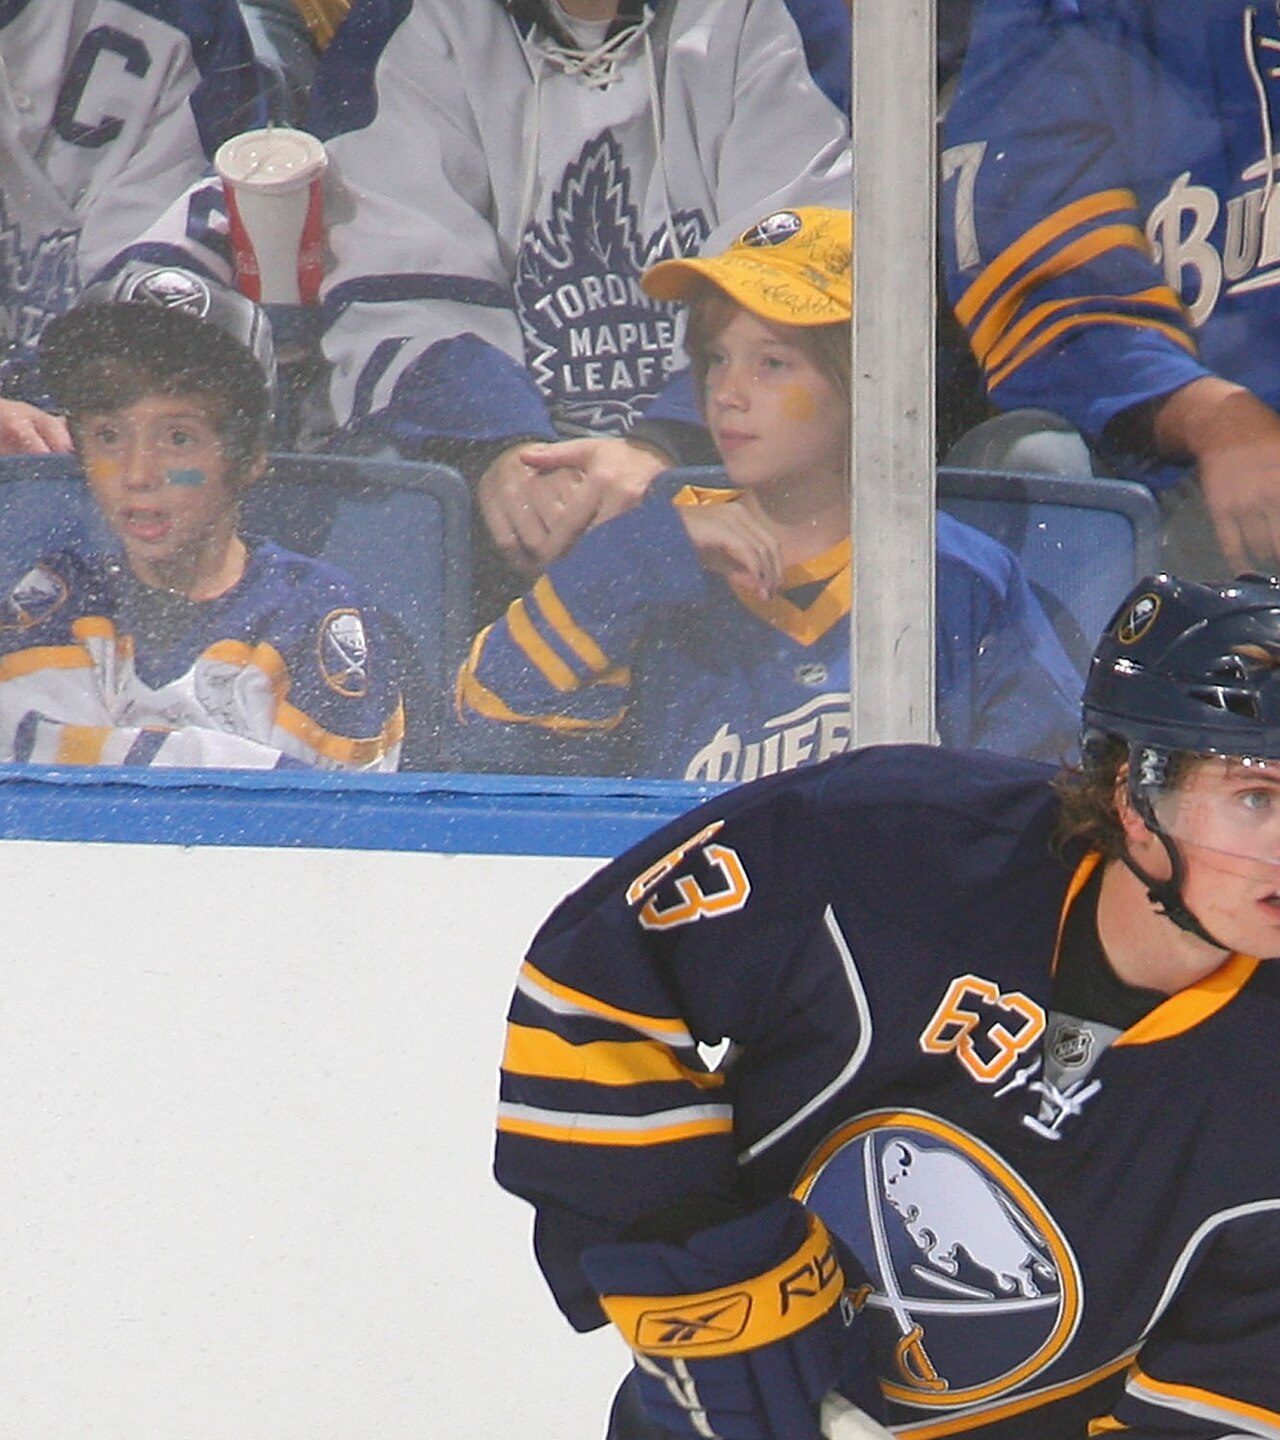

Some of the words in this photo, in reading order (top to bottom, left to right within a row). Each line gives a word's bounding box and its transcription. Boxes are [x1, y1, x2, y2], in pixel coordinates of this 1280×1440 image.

[53, 25, 152, 148] C
[940, 140, 988, 270] 7
[568, 320, 674, 358] MAPLE
[919, 974, 1047, 1084] 63
